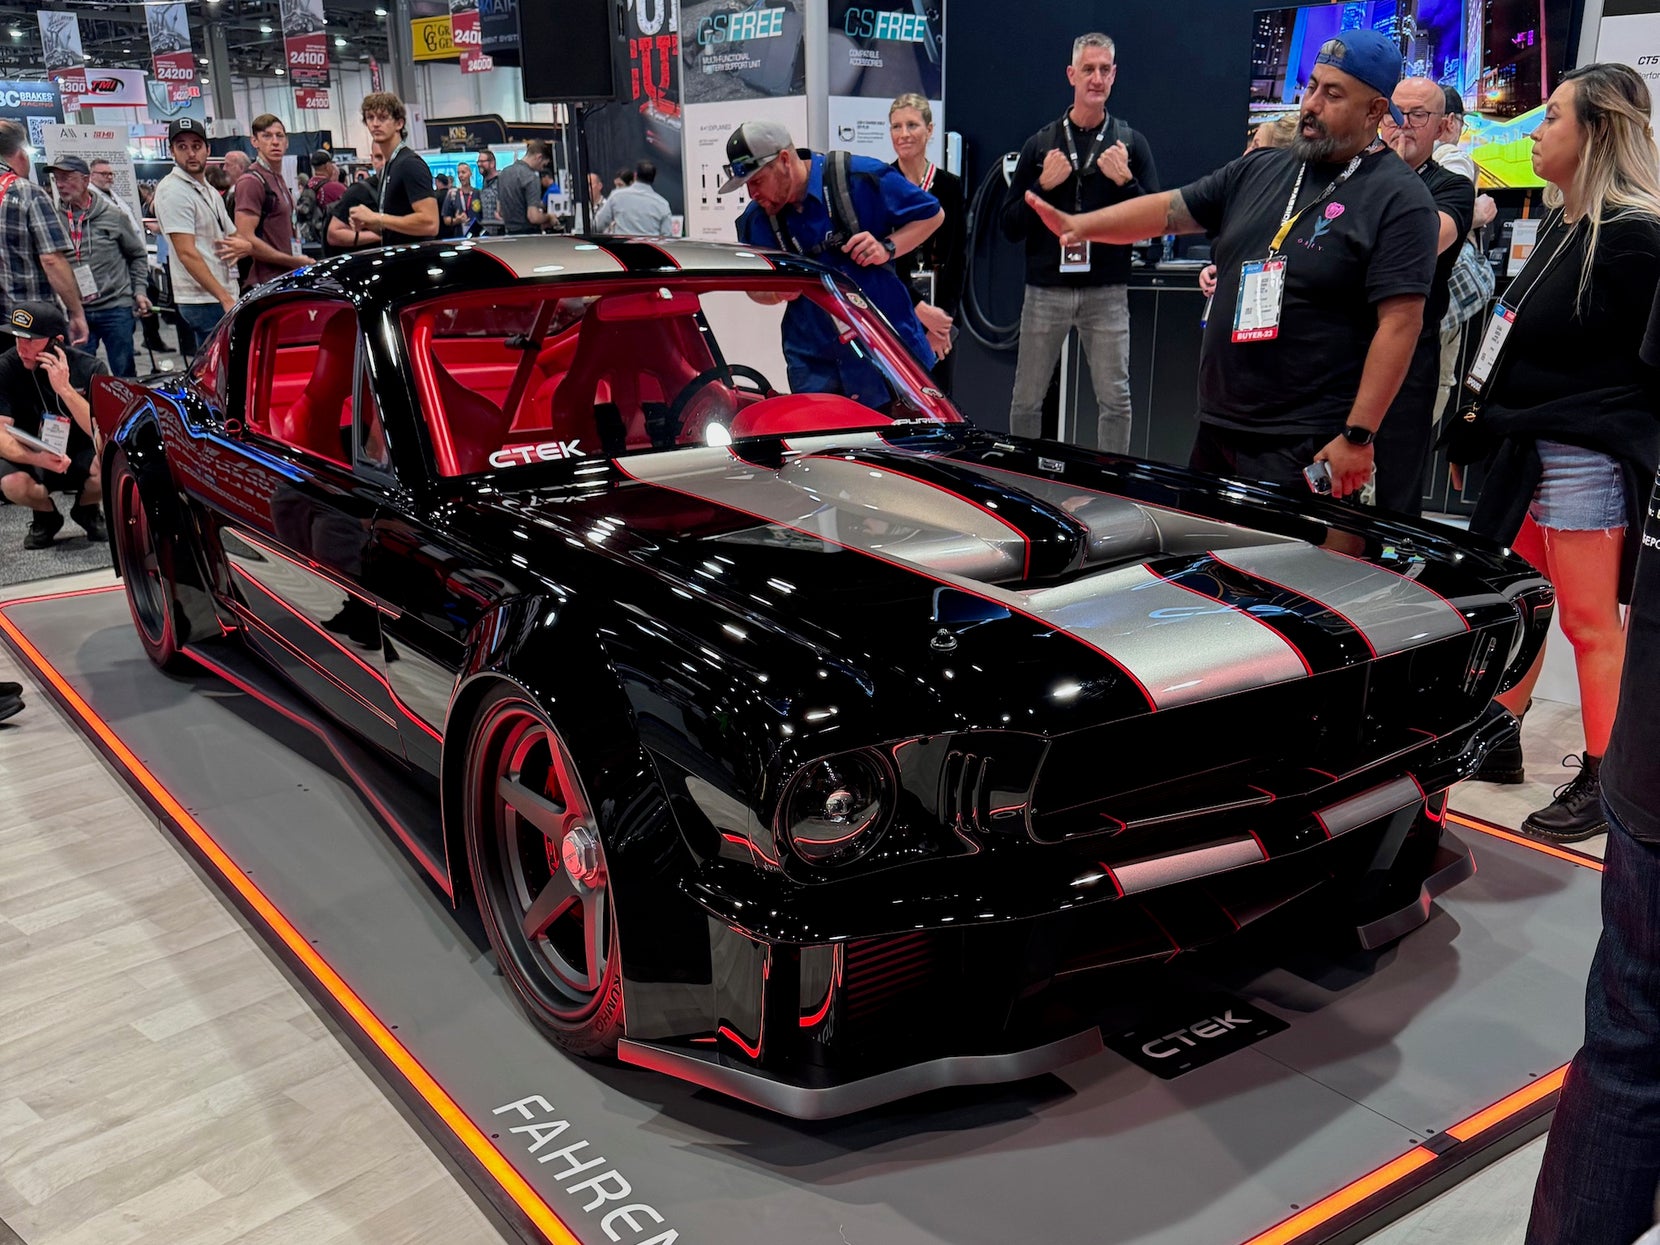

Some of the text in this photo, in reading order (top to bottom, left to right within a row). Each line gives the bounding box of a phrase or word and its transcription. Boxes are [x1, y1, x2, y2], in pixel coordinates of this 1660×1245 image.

[290, 51, 325, 65] 24100
[468, 59, 491, 71] 24000
[158, 68, 193, 79] 24200
[21, 92, 53, 100] BRAKES
[306, 98, 328, 108] 24100
[448, 126, 467, 139] KNS
[489, 439, 586, 468] CTEK
[1142, 1009, 1252, 1058] CTEK
